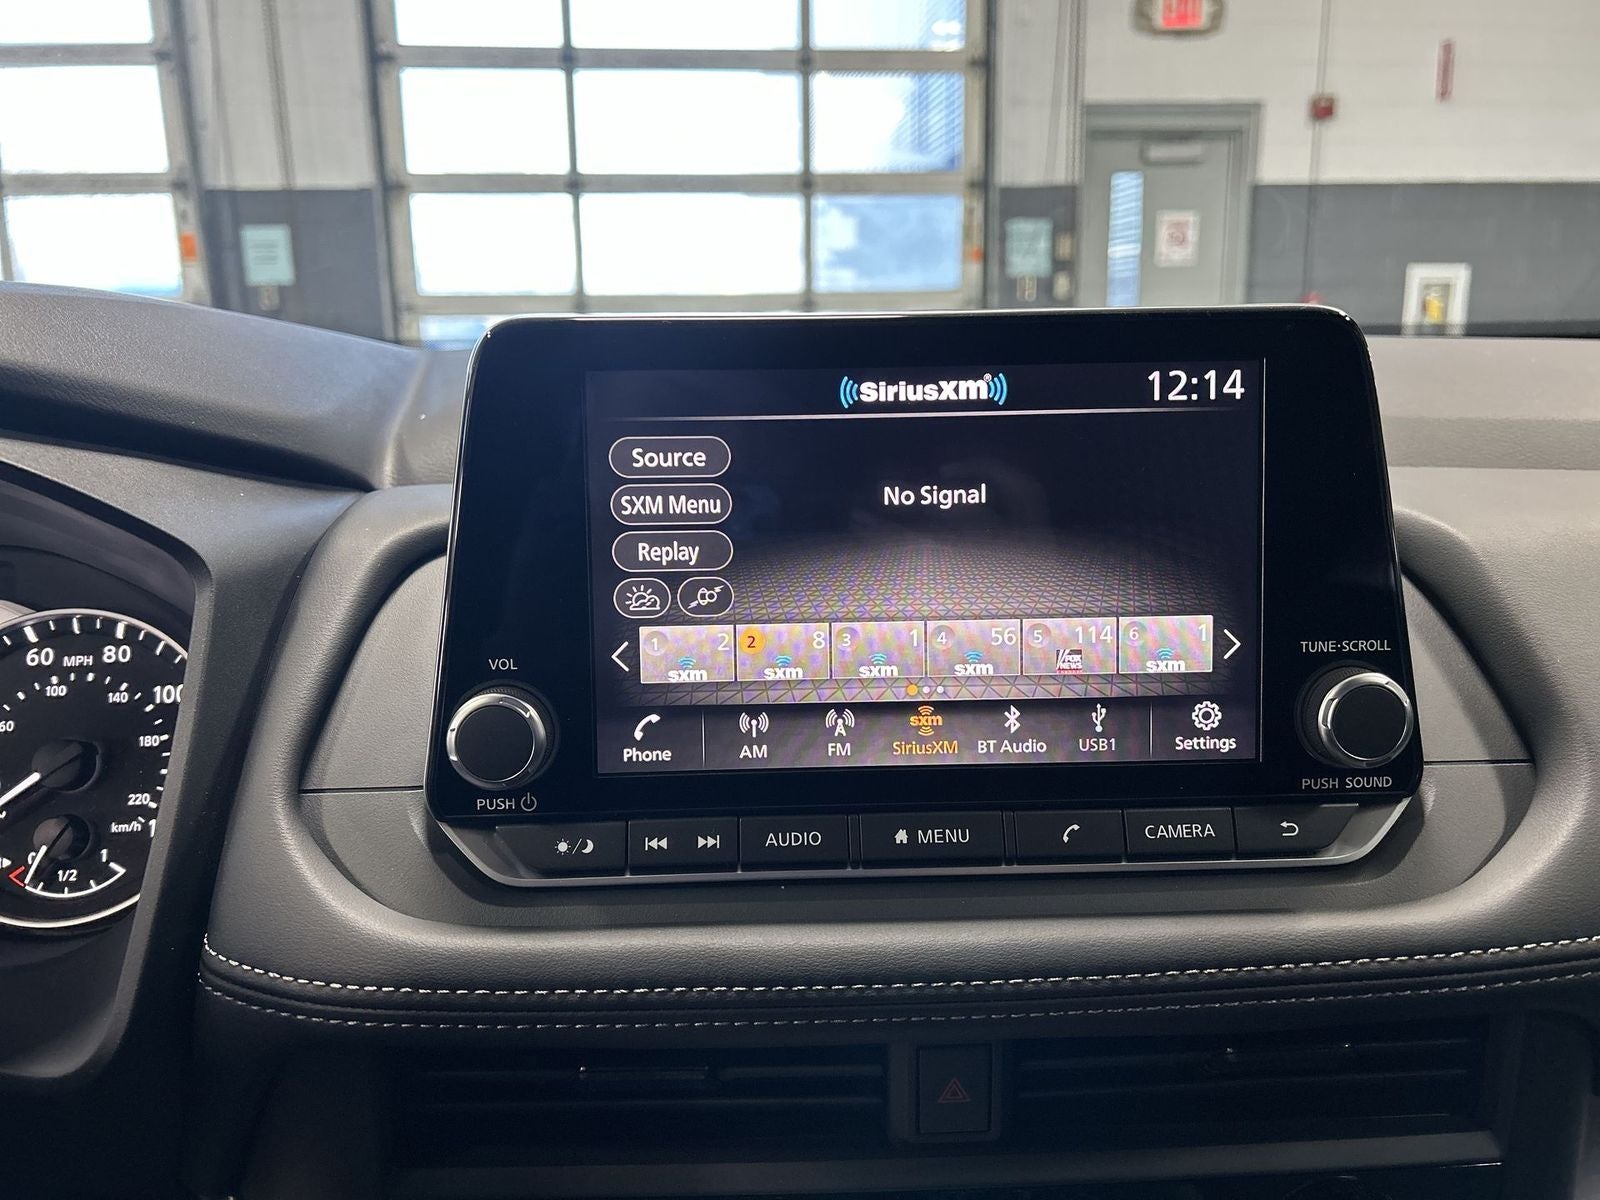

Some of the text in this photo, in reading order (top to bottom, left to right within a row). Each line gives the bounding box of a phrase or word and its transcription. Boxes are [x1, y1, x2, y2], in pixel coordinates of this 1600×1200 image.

[1147, 369, 1246, 402] 12:14
[631, 447, 707, 470] Source
[883, 483, 987, 509] No Signal
[620, 493, 721, 517] SXM Menu
[637, 542, 700, 566] Replay
[746, 631, 826, 649] 2 8
[841, 629, 919, 647] 3 1
[936, 627, 1017, 646] 4 56
[1033, 626, 1114, 644] 5 114
[1129, 624, 1207, 642] 6 1
[651, 633, 729, 651] 1 2
[26, 647, 54, 666] 60
[63, 655, 93, 667] MPH
[102, 645, 131, 664] 80
[488, 658, 518, 671] VOL
[763, 665, 803, 679] sxm
[858, 663, 898, 677] sxm
[954, 662, 994, 676] sxm
[1145, 659, 1186, 672] sxm
[667, 668, 708, 681] sxm
[45, 685, 67, 697] 100
[108, 692, 129, 704] 140
[909, 713, 943, 727] sxm
[139, 735, 160, 747] 180
[892, 739, 959, 756] SiriusXM
[978, 737, 1047, 754] BT Audio
[1079, 737, 1116, 752] USB1
[1175, 736, 1237, 752] Settings
[622, 747, 672, 763] Phone
[739, 744, 768, 759] AM
[828, 742, 851, 756] FM
[1302, 776, 1392, 790] PUSH SOUND
[128, 793, 150, 806] 220
[476, 797, 516, 811] PUSH
[111, 822, 141, 834] km/h
[1144, 823, 1216, 840] CAMERA
[765, 831, 822, 847] AUDIO
[917, 829, 970, 845] MENU
[100, 849, 108, 862] 1
[57, 869, 77, 882] 1/2
